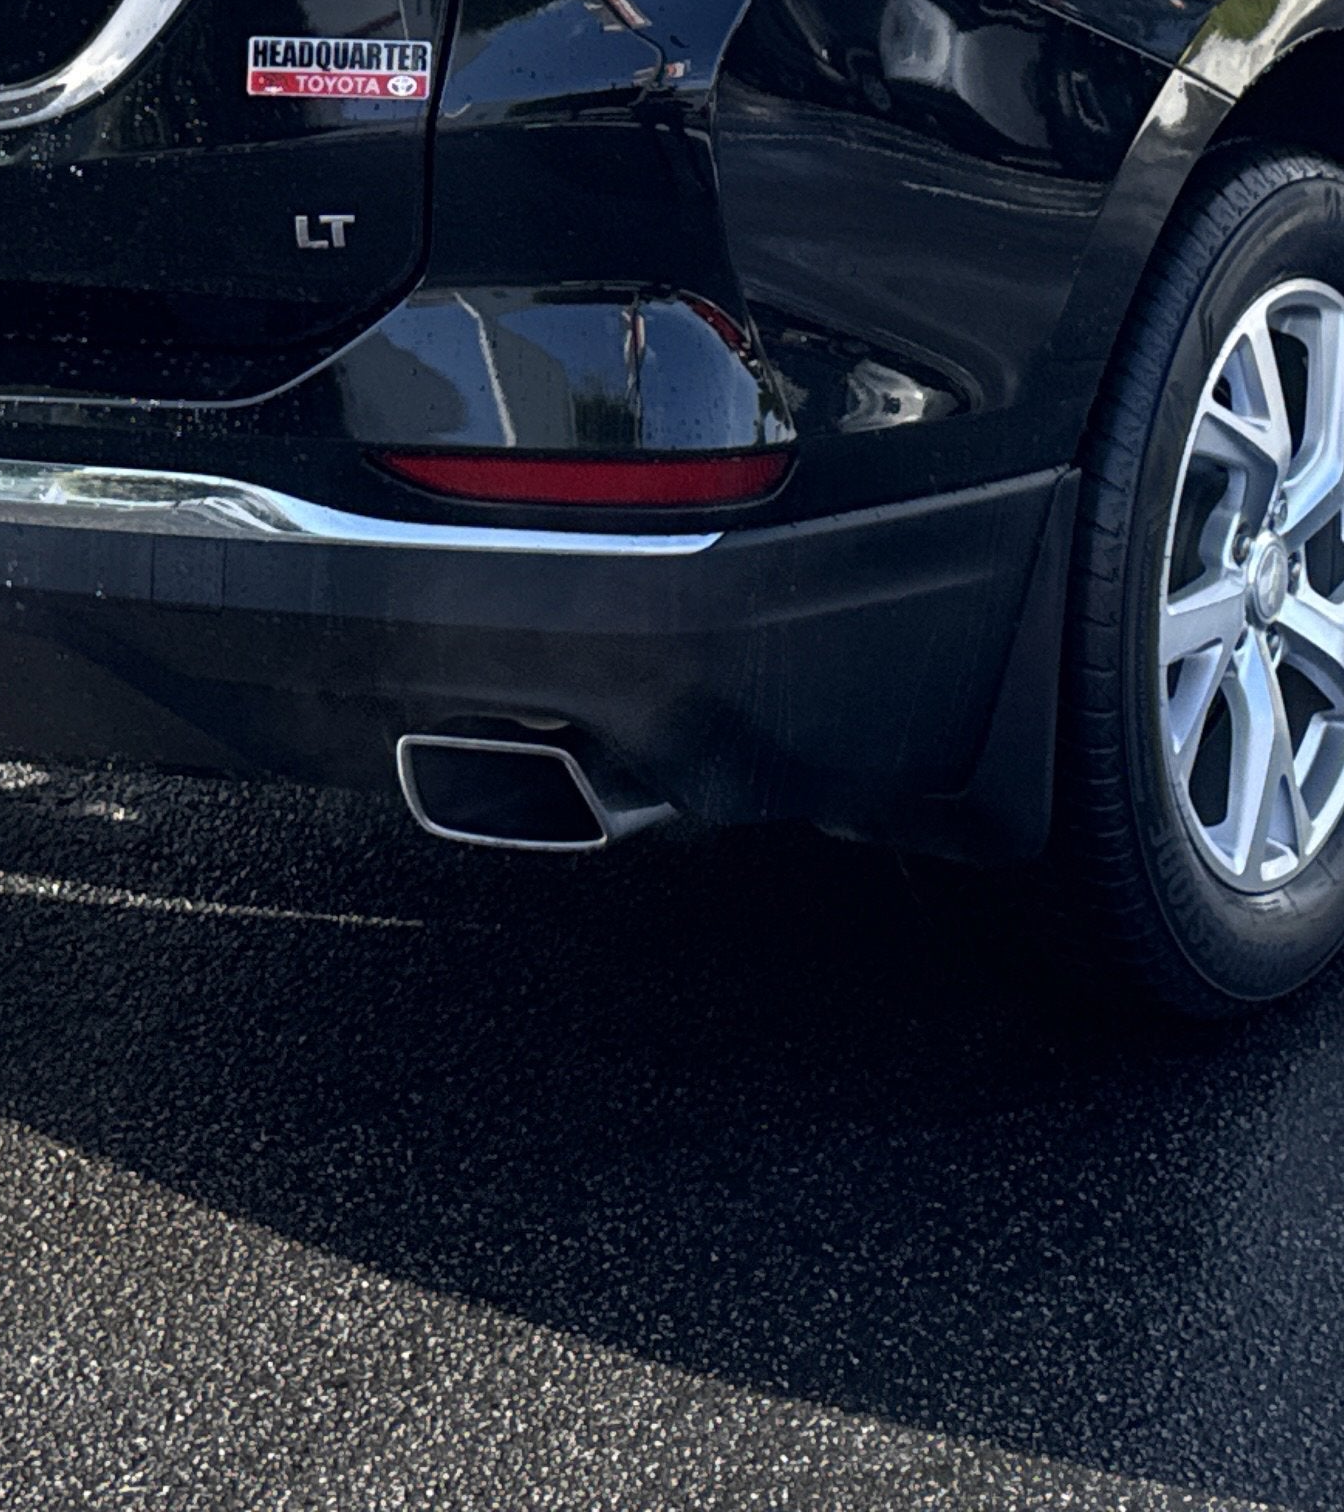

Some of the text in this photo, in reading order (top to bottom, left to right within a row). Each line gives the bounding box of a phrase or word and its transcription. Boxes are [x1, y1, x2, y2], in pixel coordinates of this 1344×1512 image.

[253, 40, 427, 71] HEADQUARTER
[296, 75, 380, 94] TOYOTA
[295, 214, 355, 248] LT
